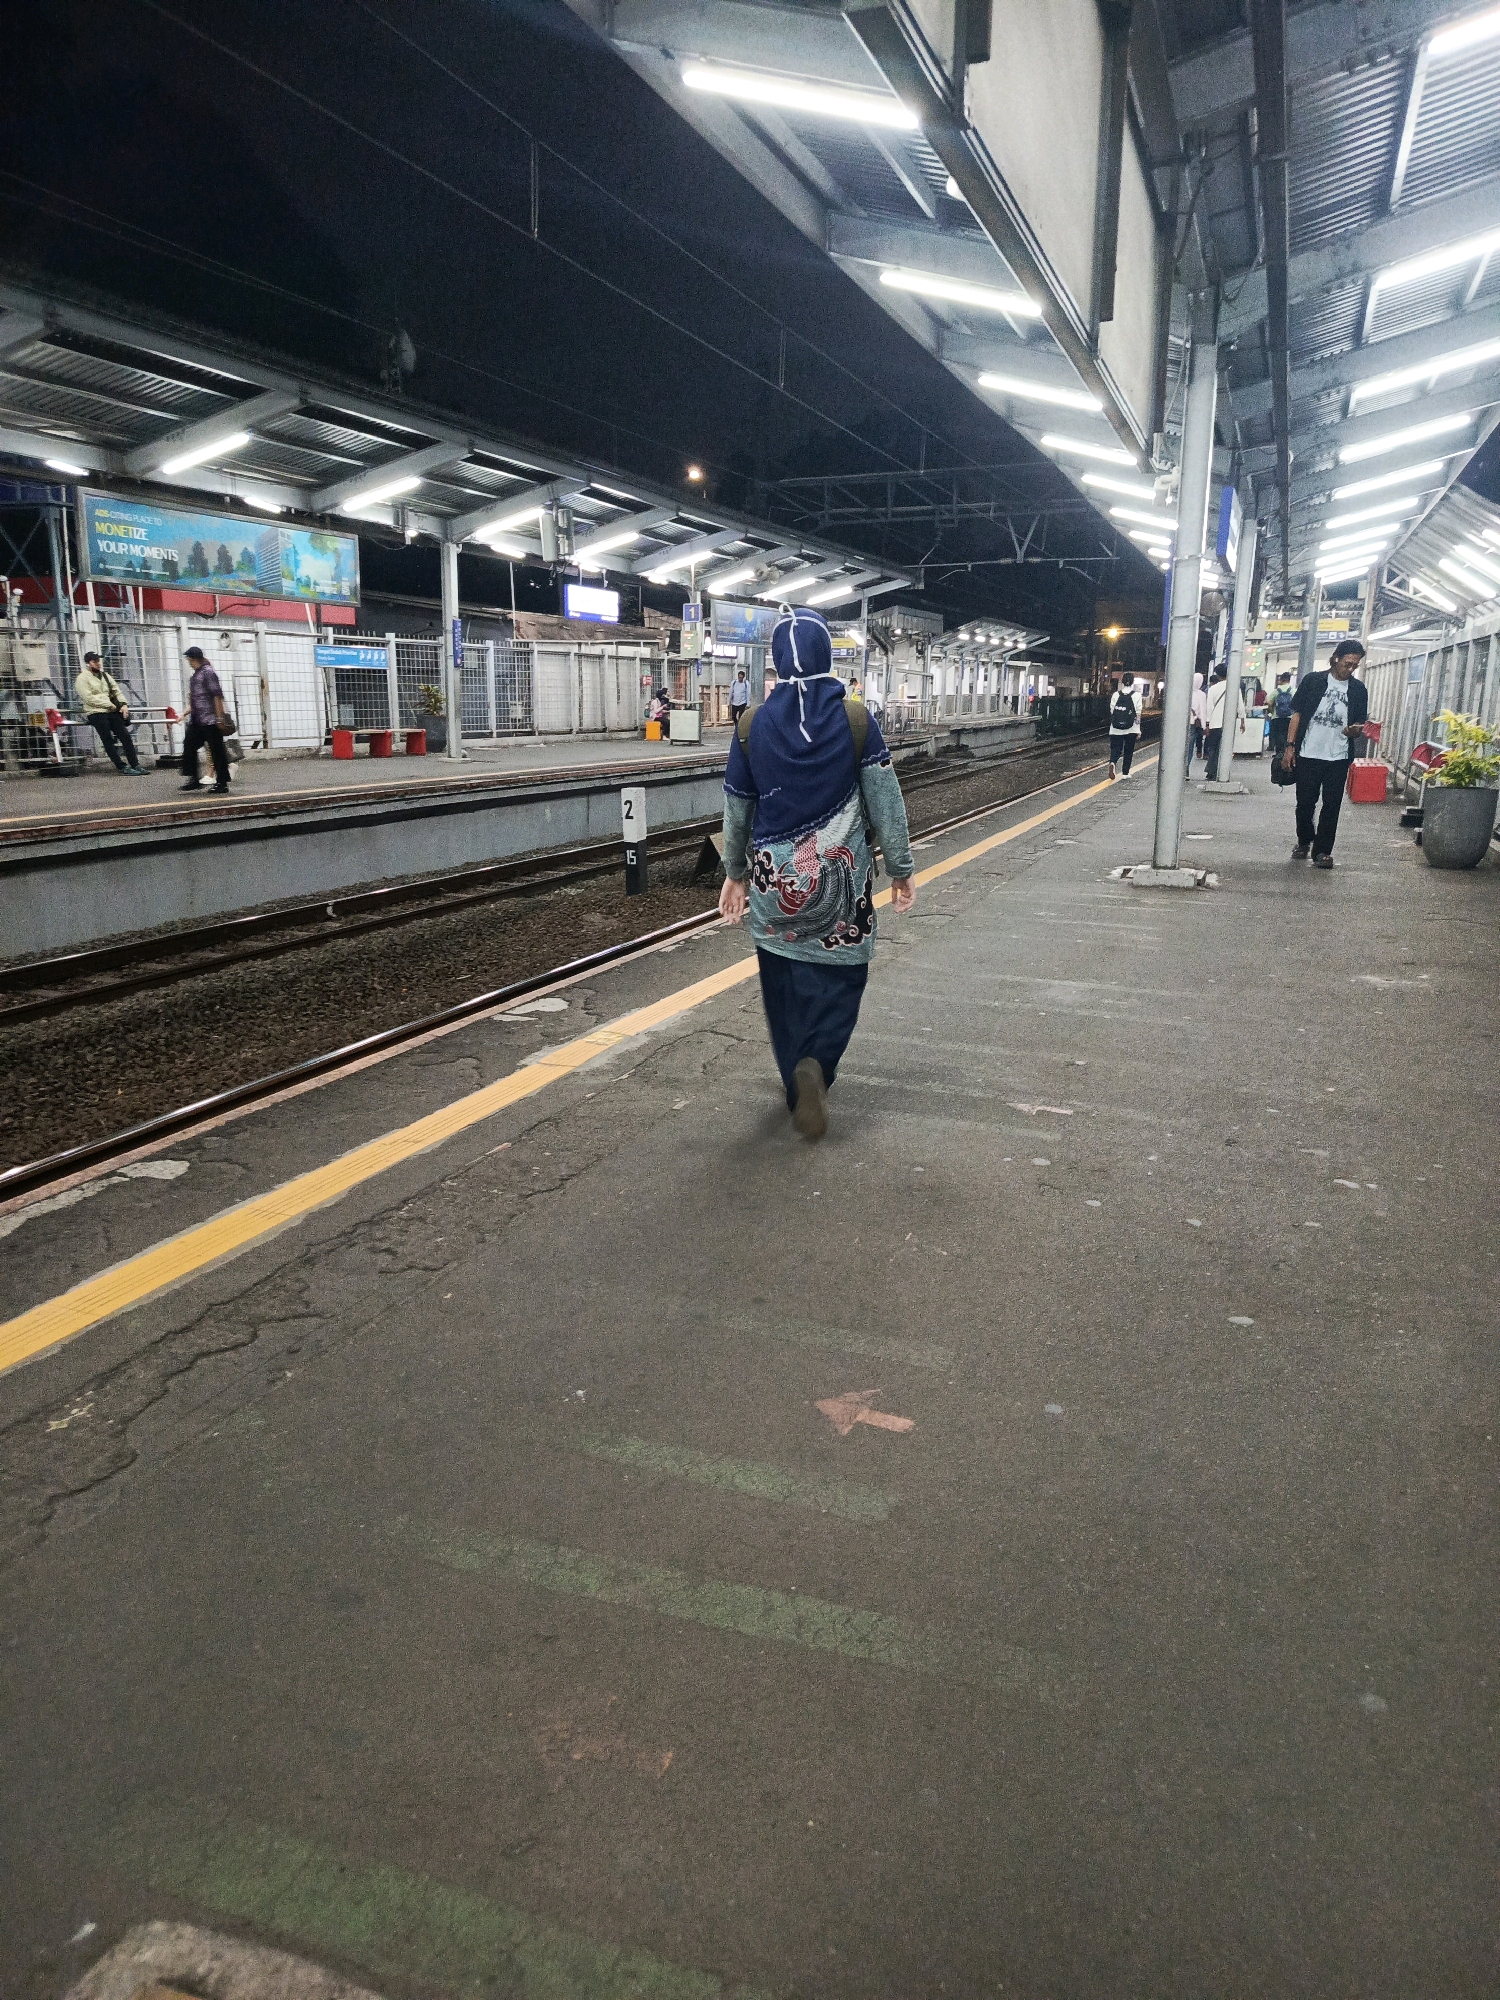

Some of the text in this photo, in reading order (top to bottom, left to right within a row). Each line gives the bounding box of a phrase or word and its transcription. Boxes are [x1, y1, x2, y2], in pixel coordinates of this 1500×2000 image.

[133, 514, 153, 525] PLACE
[154, 517, 162, 526] TO
[95, 521, 149, 541] MONETIZE
[97, 540, 179, 562] YOUR MOMENTS
[688, 606, 696, 619] 1
[623, 800, 634, 820] 2
[626, 849, 637, 865] 15
